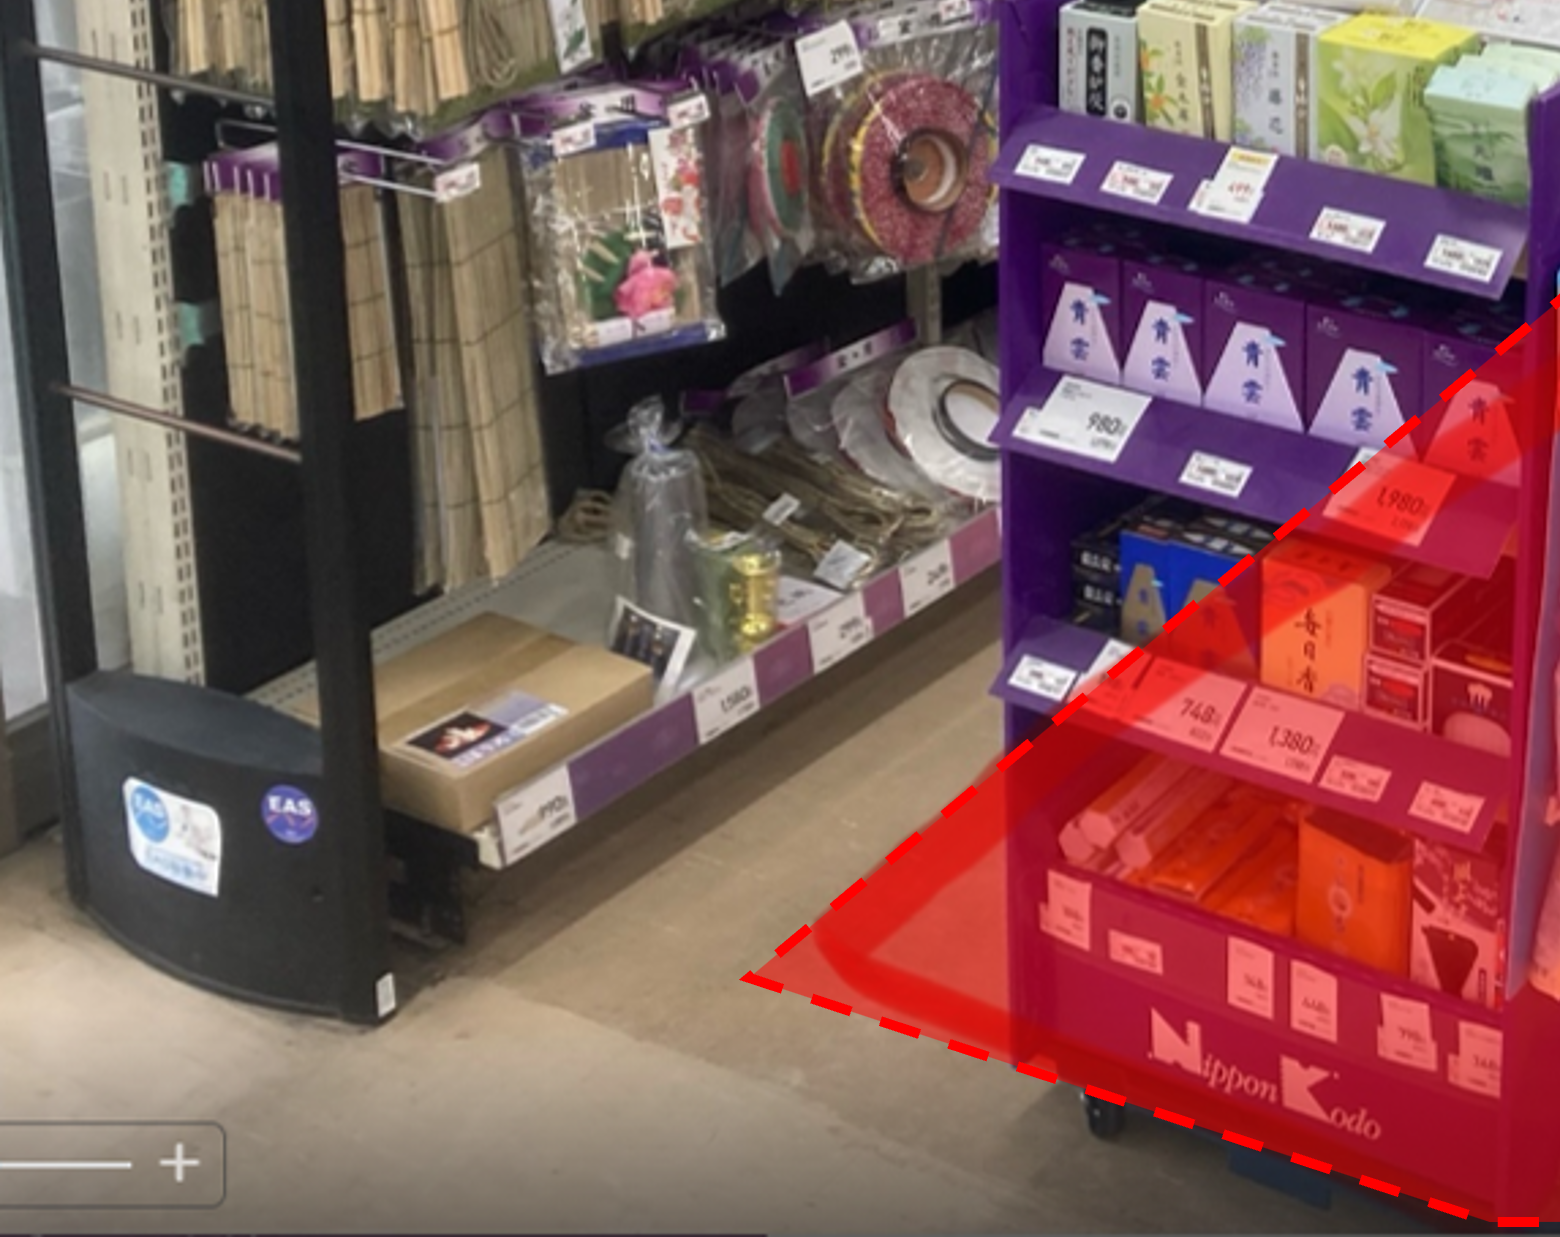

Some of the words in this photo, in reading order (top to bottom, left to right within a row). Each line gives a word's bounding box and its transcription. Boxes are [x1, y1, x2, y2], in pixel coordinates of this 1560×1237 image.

[1069, 296, 1092, 362] 青雲
[1150, 316, 1172, 382] 青雲
[1241, 339, 1265, 406] 青雲
[1349, 365, 1375, 434] 青雲
[1295, 608, 1322, 694] 毎日香
[267, 794, 312, 817] EAS
[1147, 1008, 1280, 1106] Nippon
[1280, 1054, 1382, 1143] Kodo
